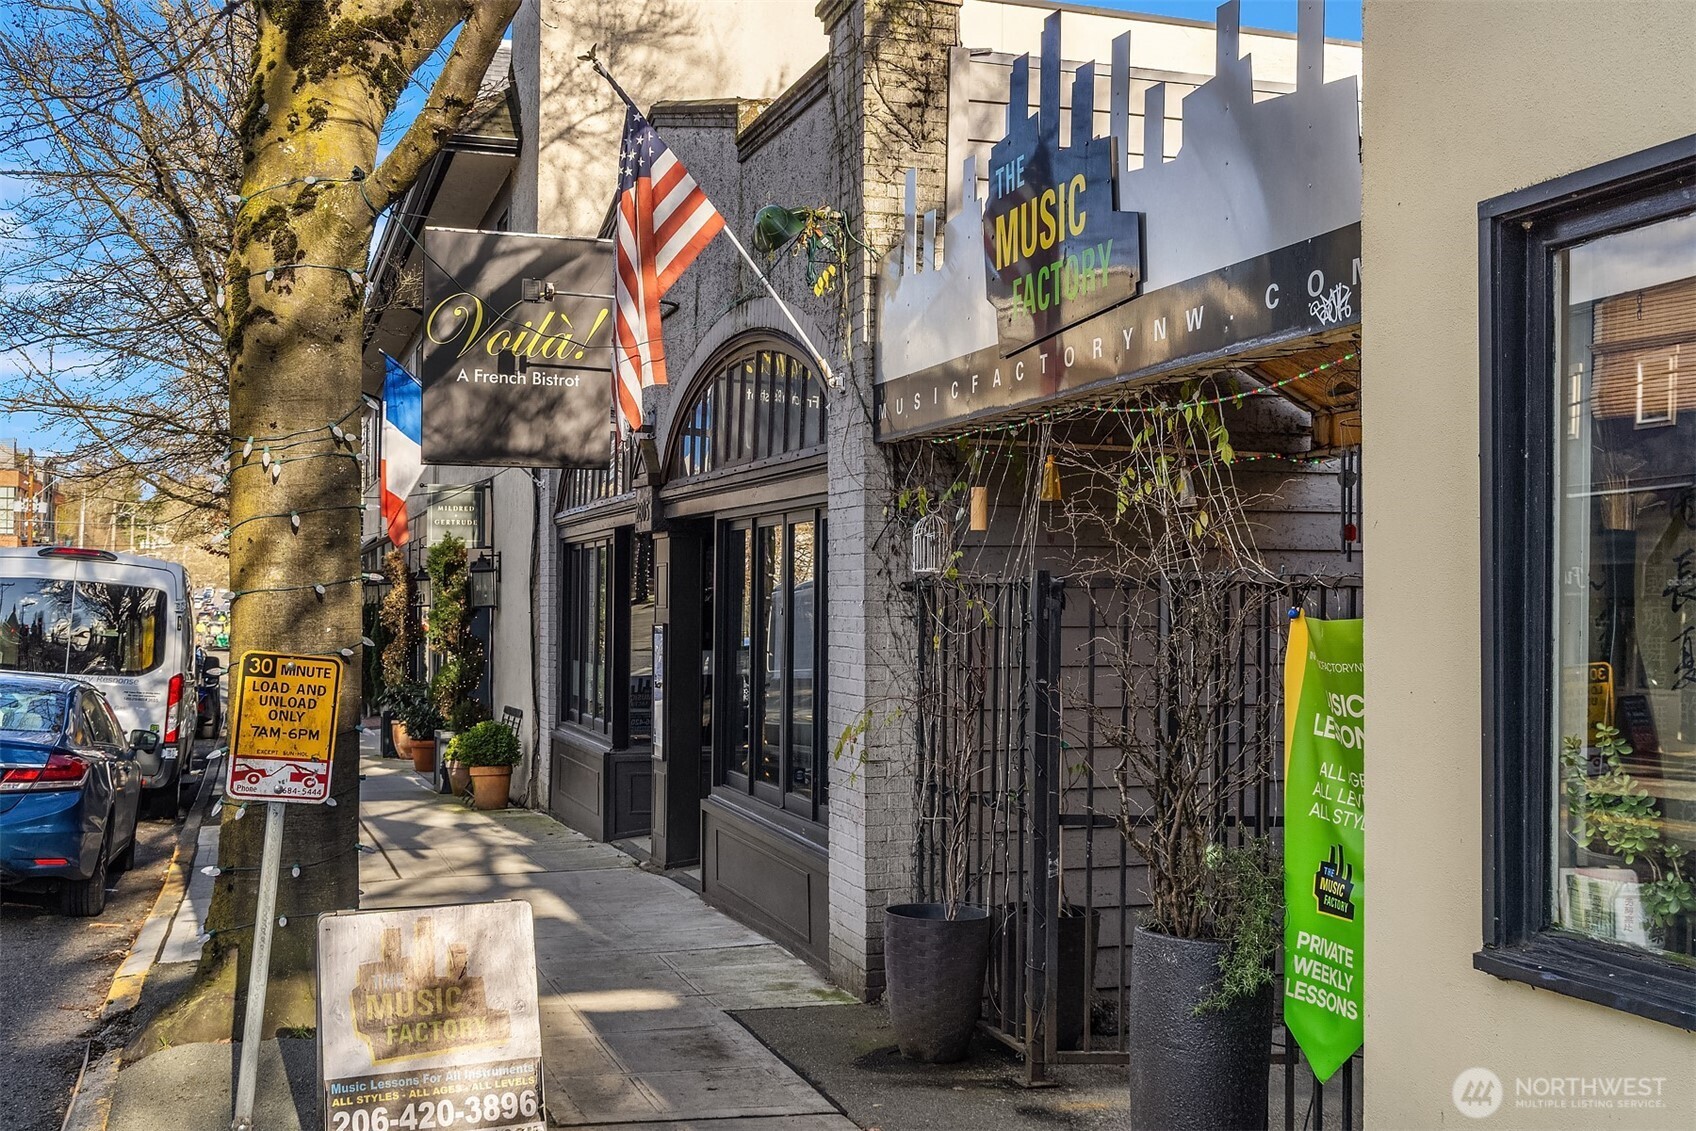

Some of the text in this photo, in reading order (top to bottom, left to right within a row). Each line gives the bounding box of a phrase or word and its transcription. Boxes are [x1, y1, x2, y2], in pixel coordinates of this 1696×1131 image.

[995, 154, 1025, 199] THE
[995, 173, 1086, 271] MUSIC
[1012, 239, 1113, 321] FACTORY
[426, 292, 609, 360] Voilà!
[456, 368, 580, 387] A French Bistrot
[248, 657, 332, 679] 30 MINUTE
[252, 681, 327, 697] LOAD AND
[259, 695, 317, 710] UNLOAD
[268, 710, 306, 722] ONLY
[251, 726, 320, 741] 7AM-6PM
[1319, 761, 1346, 782] ALL
[236, 784, 322, 796] Phone 684-5444
[1312, 781, 1332, 801] ALL
[1308, 802, 1331, 822] ALL
[1323, 866, 1335, 878] THE
[1319, 876, 1346, 898] MUSIC
[1323, 894, 1349, 913] FACTORY
[1296, 930, 1354, 969] PRIVATE
[371, 971, 406, 990] THE
[1293, 954, 1354, 993] WEEKLY
[365, 985, 463, 1020] MUSIC
[1285, 977, 1358, 1021] LESSONS
[386, 1015, 487, 1046] FACTORY
[331, 1064, 535, 1095] Music Lessons For All Instruments
[331, 1097, 354, 1107] ALL
[356, 1092, 400, 1104] STYLES
[409, 1088, 430, 1099] ALL
[432, 1085, 463, 1096] AGES
[471, 1080, 491, 1091] ALL
[494, 1076, 535, 1089] LEVELS
[332, 1089, 537, 1131] 206-420-3896
